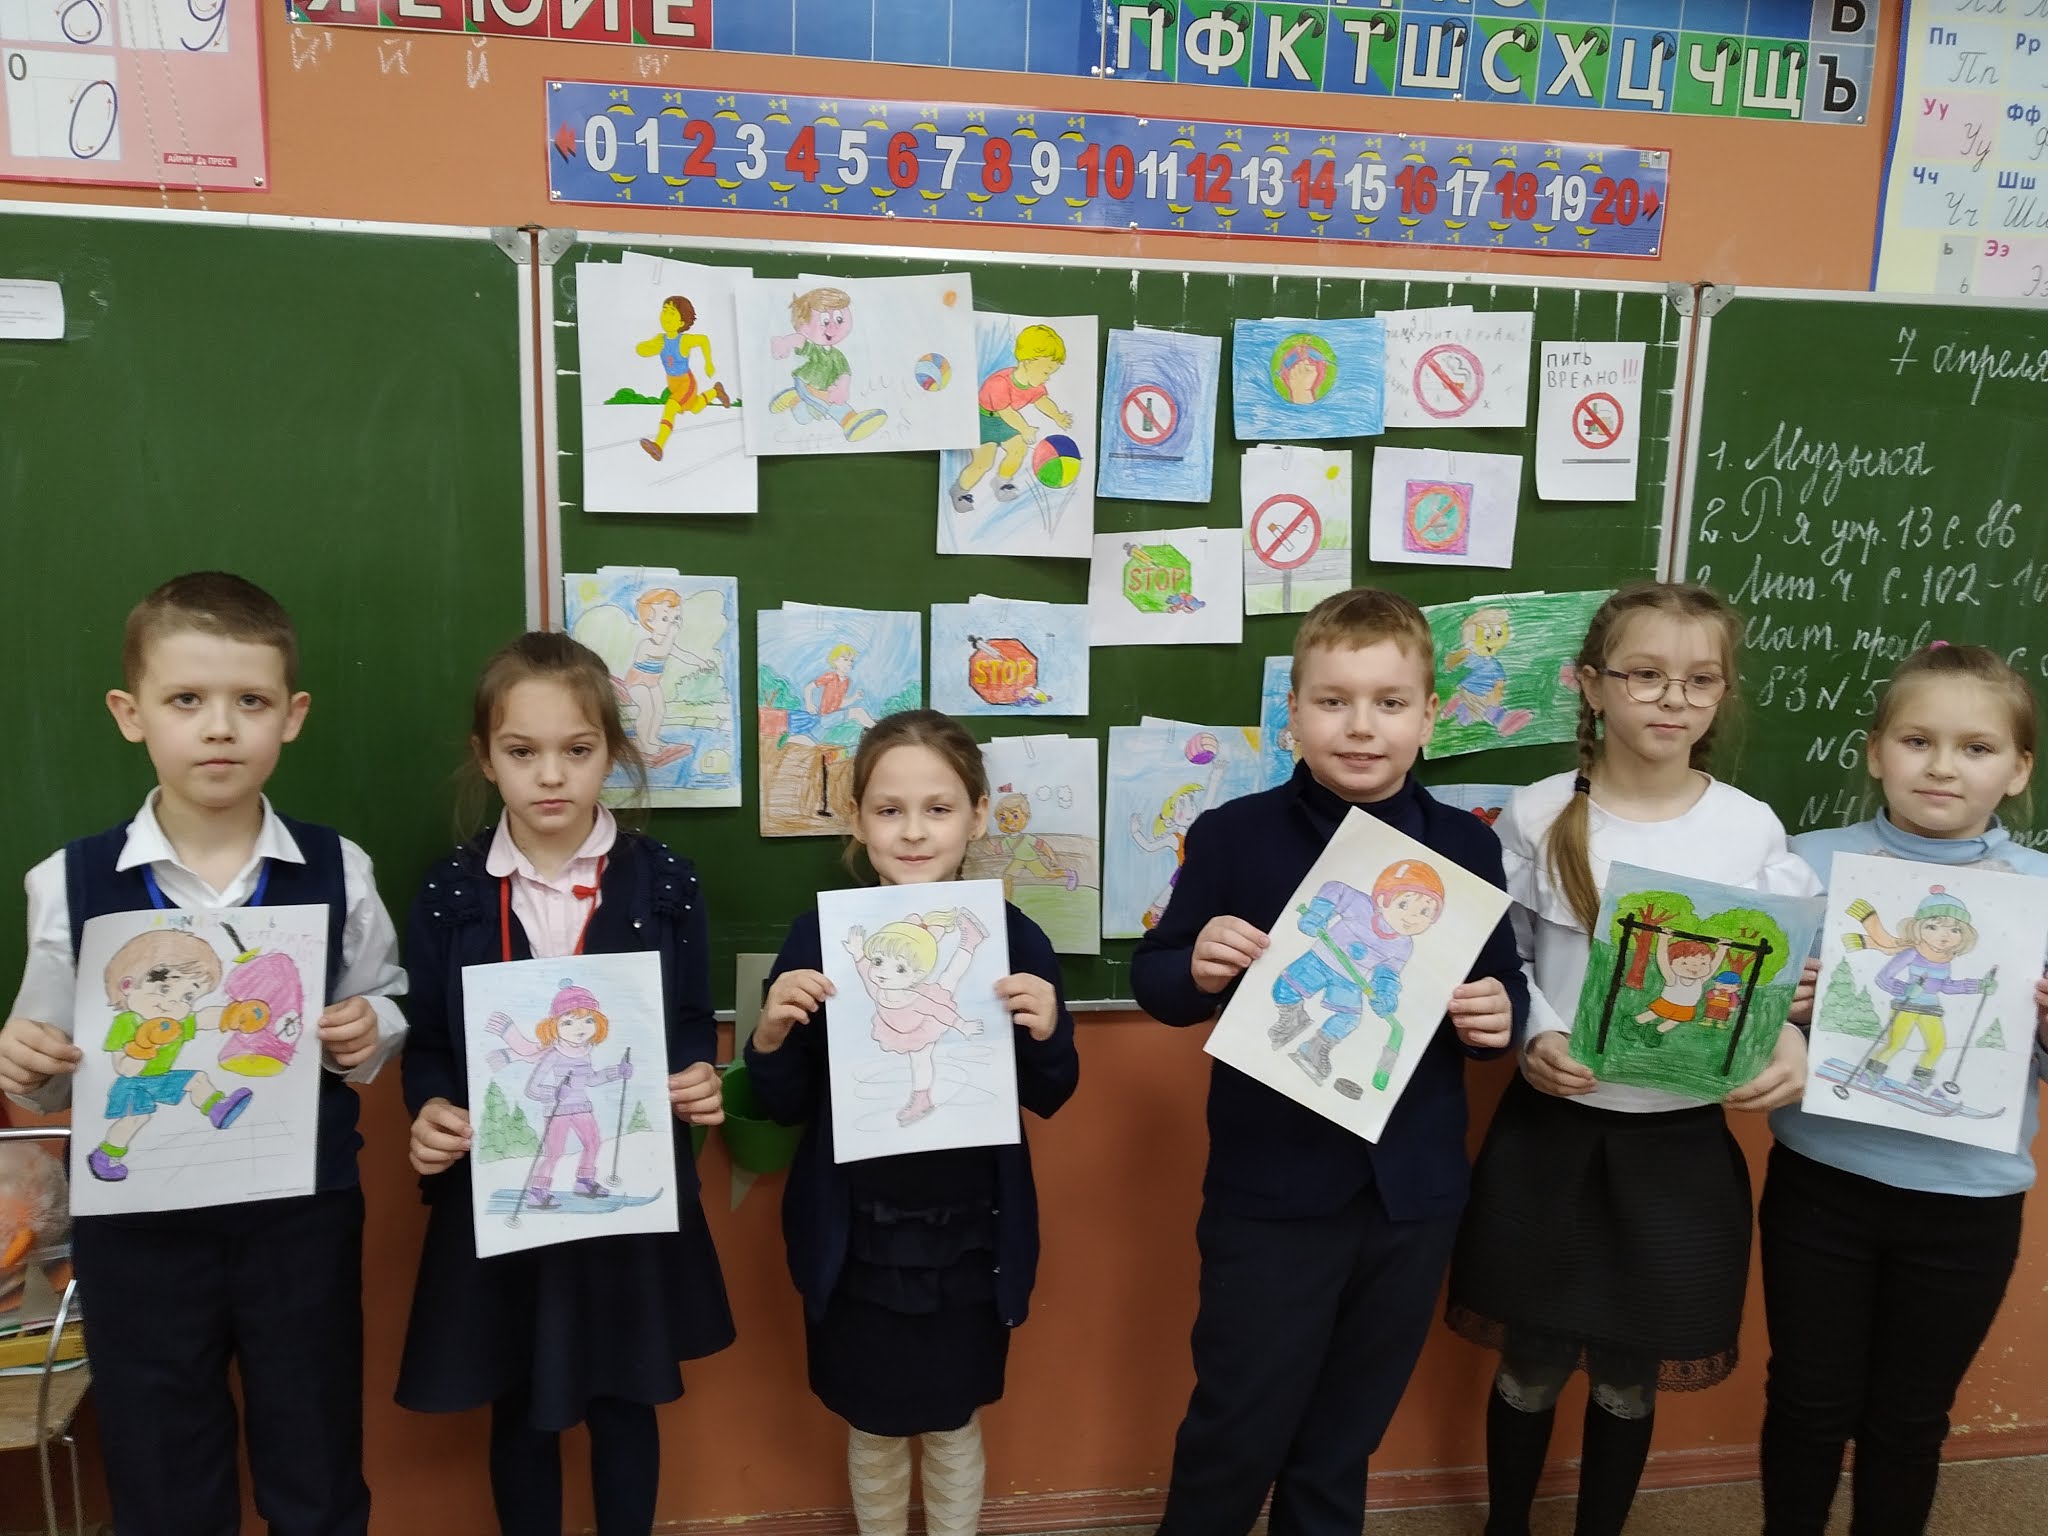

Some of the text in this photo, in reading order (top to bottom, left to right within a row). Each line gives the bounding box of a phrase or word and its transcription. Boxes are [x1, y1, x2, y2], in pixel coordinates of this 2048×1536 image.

[1929, 27, 2042, 56] Пп Рр
[1116, 5, 1859, 119] П Ф К Т Ш С Х Ц Ч Щ Ъ
[609, 89, 1603, 162] +1 +1 +1 +1 +1 +1 +1 +1 +1 +1 +1 +1 +1 +1 +1 +1 +1 +1 +1 +1
[1923, 98, 2041, 126] Уу Фф
[208, 157, 232, 167] ПРЕСС
[585, 114, 1640, 227] 0 1 2 3 4 5 6 7 8 9 10 11 12 13 14 15 16 17 18 19 20
[1912, 166, 2036, 190] Чч Шш
[616, 188, 631, 200] -1
[669, 191, 684, 203] -1
[722, 193, 737, 205] -1
[774, 196, 788, 208] -1
[823, 199, 839, 210] -1
[872, 202, 887, 213] -1
[923, 204, 938, 215] -1
[969, 206, 983, 217] -1
[1018, 209, 1033, 220] -1
[1068, 211, 1083, 222] -1
[1170, 217, 1184, 228] -1
[1217, 220, 1232, 231] -1
[1265, 222, 1279, 233] -1
[1311, 225, 1325, 236] -1
[1356, 227, 1370, 238] -1
[1400, 230, 1414, 240] -1
[1446, 232, 1461, 243] -1
[1490, 234, 1504, 244] -1
[1534, 236, 1548, 246] -1
[1576, 239, 1590, 249] -1
[1546, 352, 1593, 368] ПИТЬ
[1889, 326, 1919, 375] 7
[1708, 420, 1936, 507] 1. Музыка
[1898, 506, 1934, 550] 13
[1128, 566, 1187, 592] STOP
[974, 658, 1033, 686] STOP
